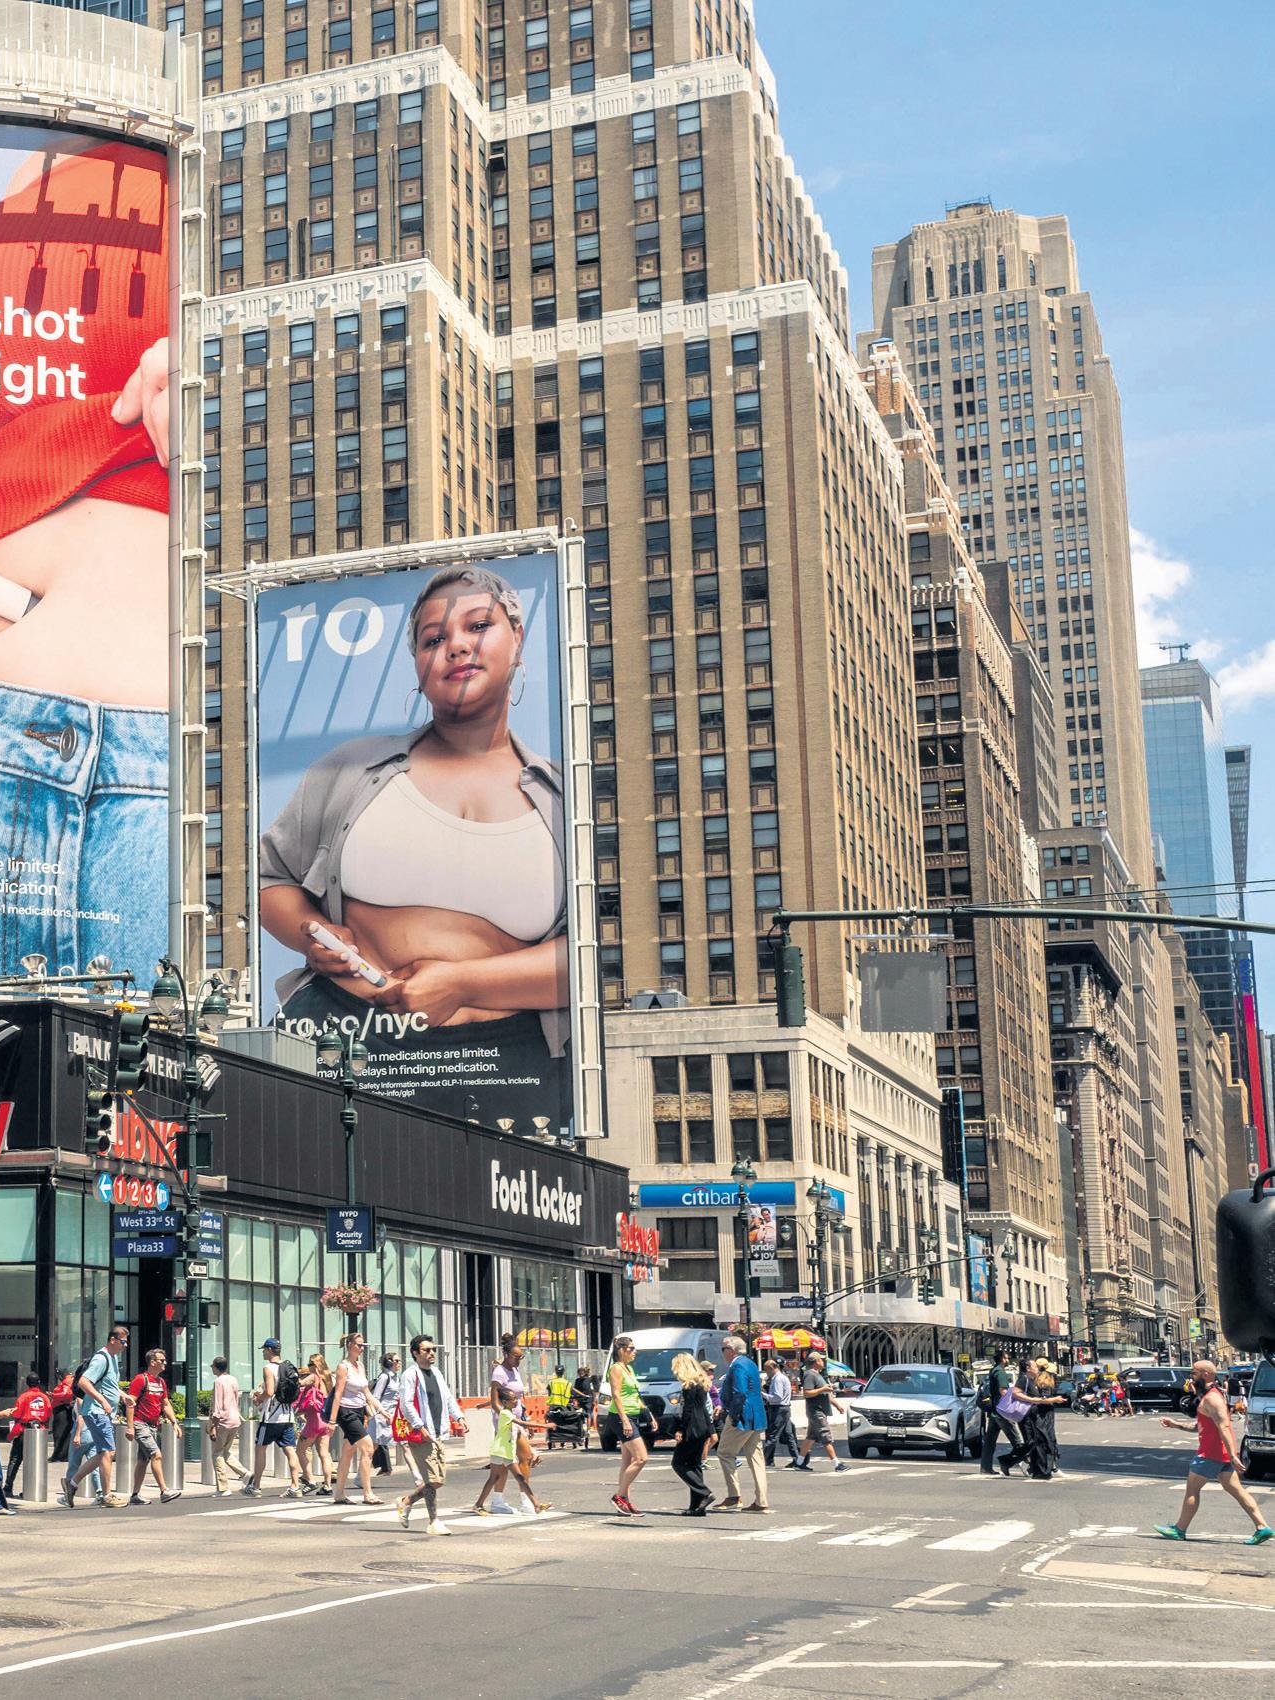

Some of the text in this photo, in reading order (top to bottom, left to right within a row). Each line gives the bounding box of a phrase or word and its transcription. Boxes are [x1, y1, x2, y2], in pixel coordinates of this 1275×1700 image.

[280, 597, 384, 662] ro
[7, 857, 65, 876] limited.
[7, 906, 74, 919] medications,
[75, 908, 121, 924] including
[285, 1008, 430, 1041] ro.co/nyc
[67, 1032, 112, 1061] BANK
[378, 1050, 442, 1062] medications
[443, 1050, 461, 1060] are
[462, 1047, 501, 1059] limited.
[317, 1069, 340, 1080] may
[388, 1065, 399, 1075] in
[399, 1063, 436, 1076] finding
[437, 1061, 499, 1074] medication.
[358, 1076, 541, 1091] Safety Information about GLP-1 medications, including
[490, 1159, 582, 1226] Foot Locker
[339, 1210, 359, 1218] NYPD
[120, 1216, 175, 1228] West 33rd St
[336, 1231, 363, 1239] Security
[616, 1211, 660, 1265] Subway
[127, 1241, 164, 1253] Plaza33
[751, 1240, 775, 1253] pride
[760, 1252, 775, 1261] joy
